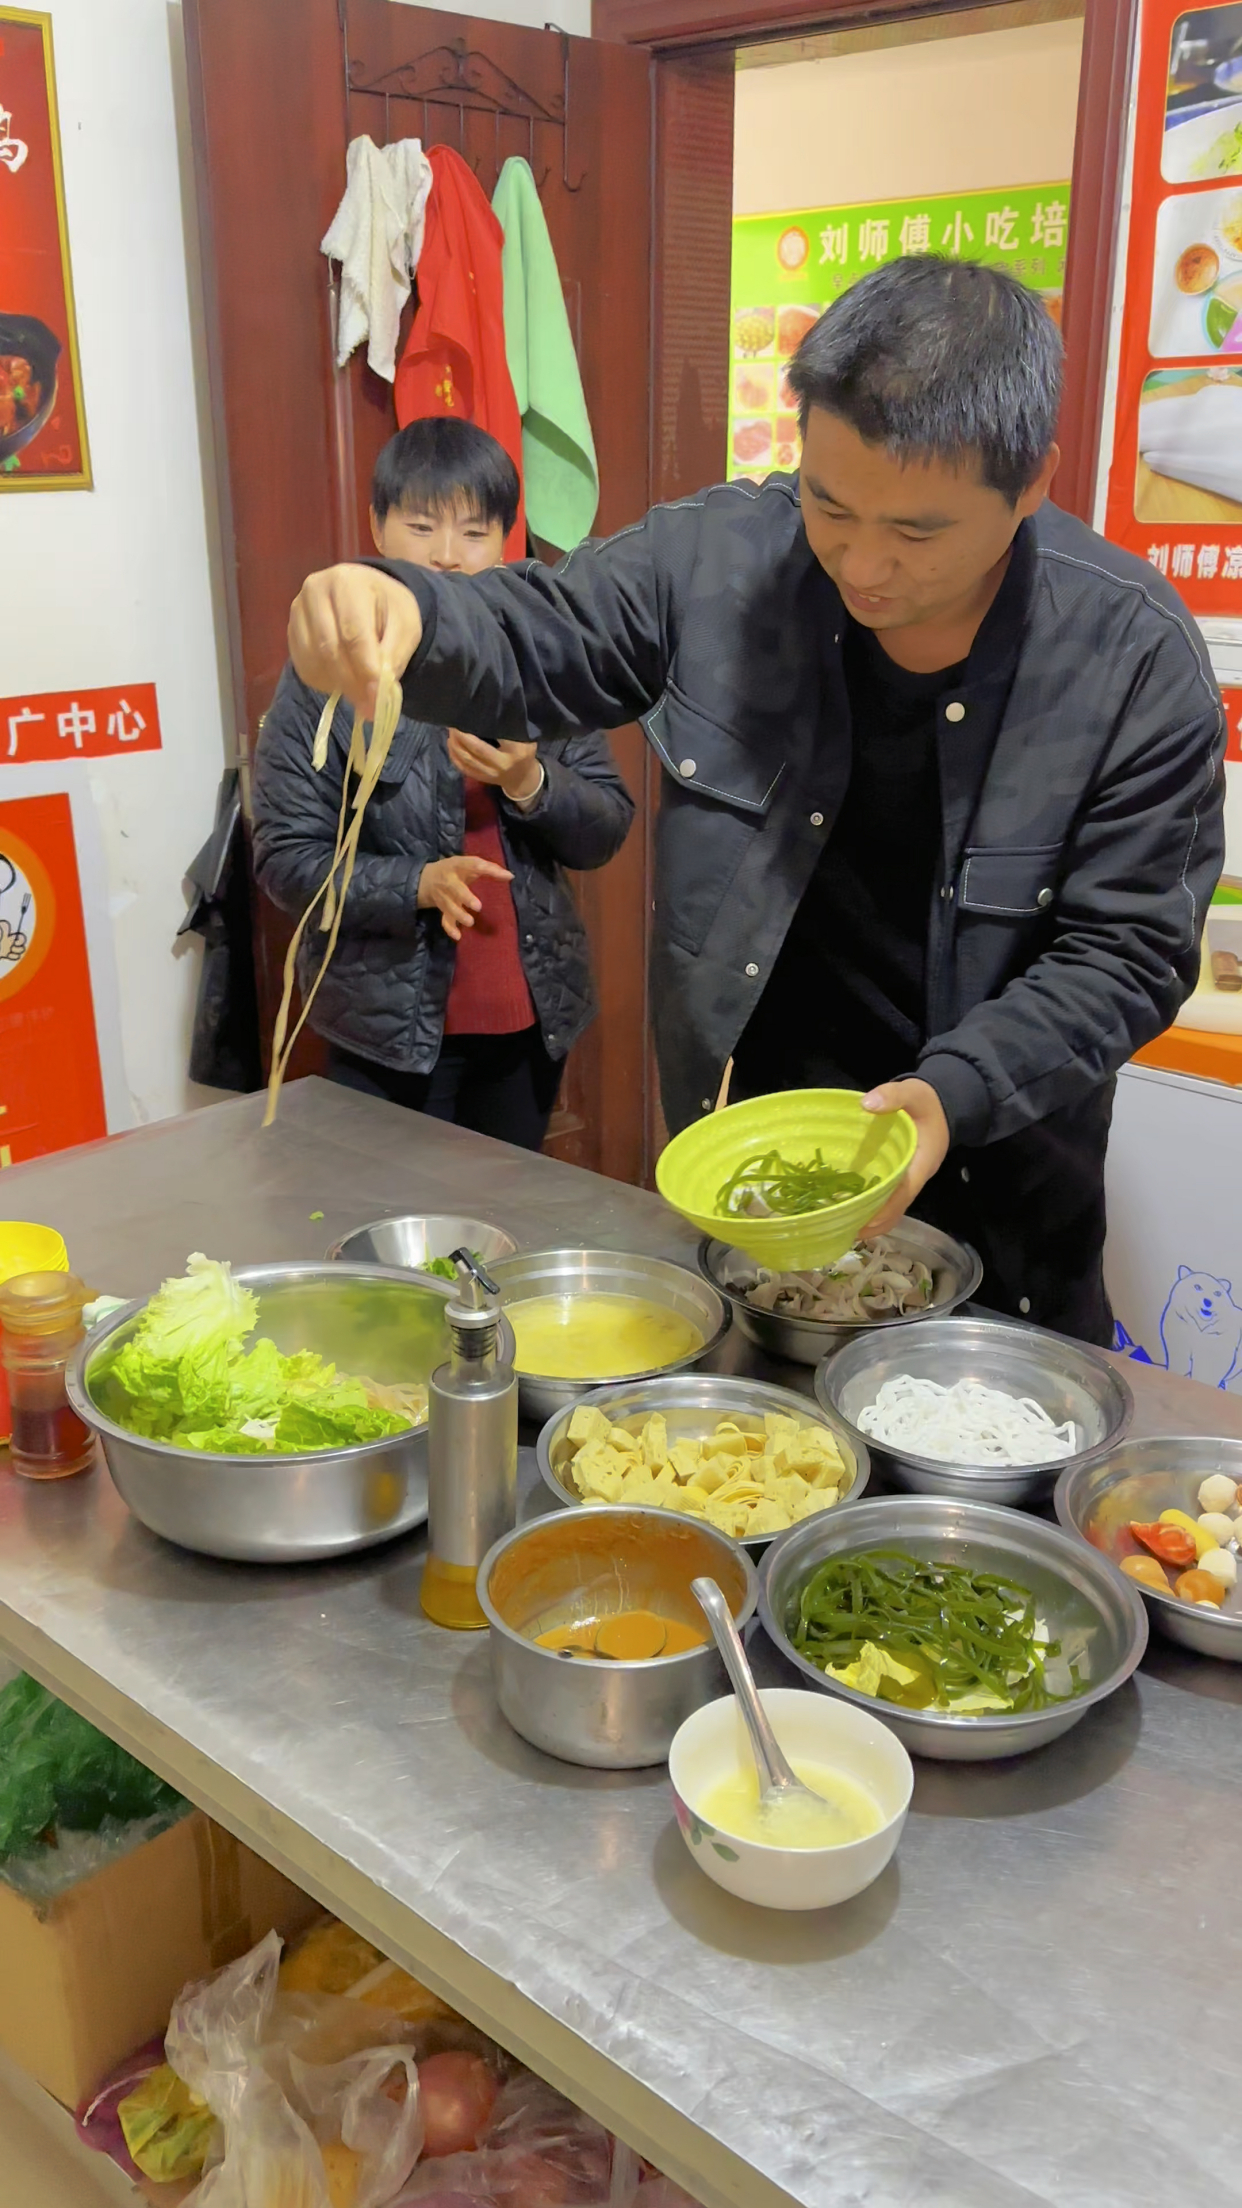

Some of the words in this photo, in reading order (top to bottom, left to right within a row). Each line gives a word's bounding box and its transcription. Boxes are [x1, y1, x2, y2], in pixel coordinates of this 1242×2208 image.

[819, 200, 1067, 265] 刘师傅小吃培
[7, 699, 147, 756] 广中心
